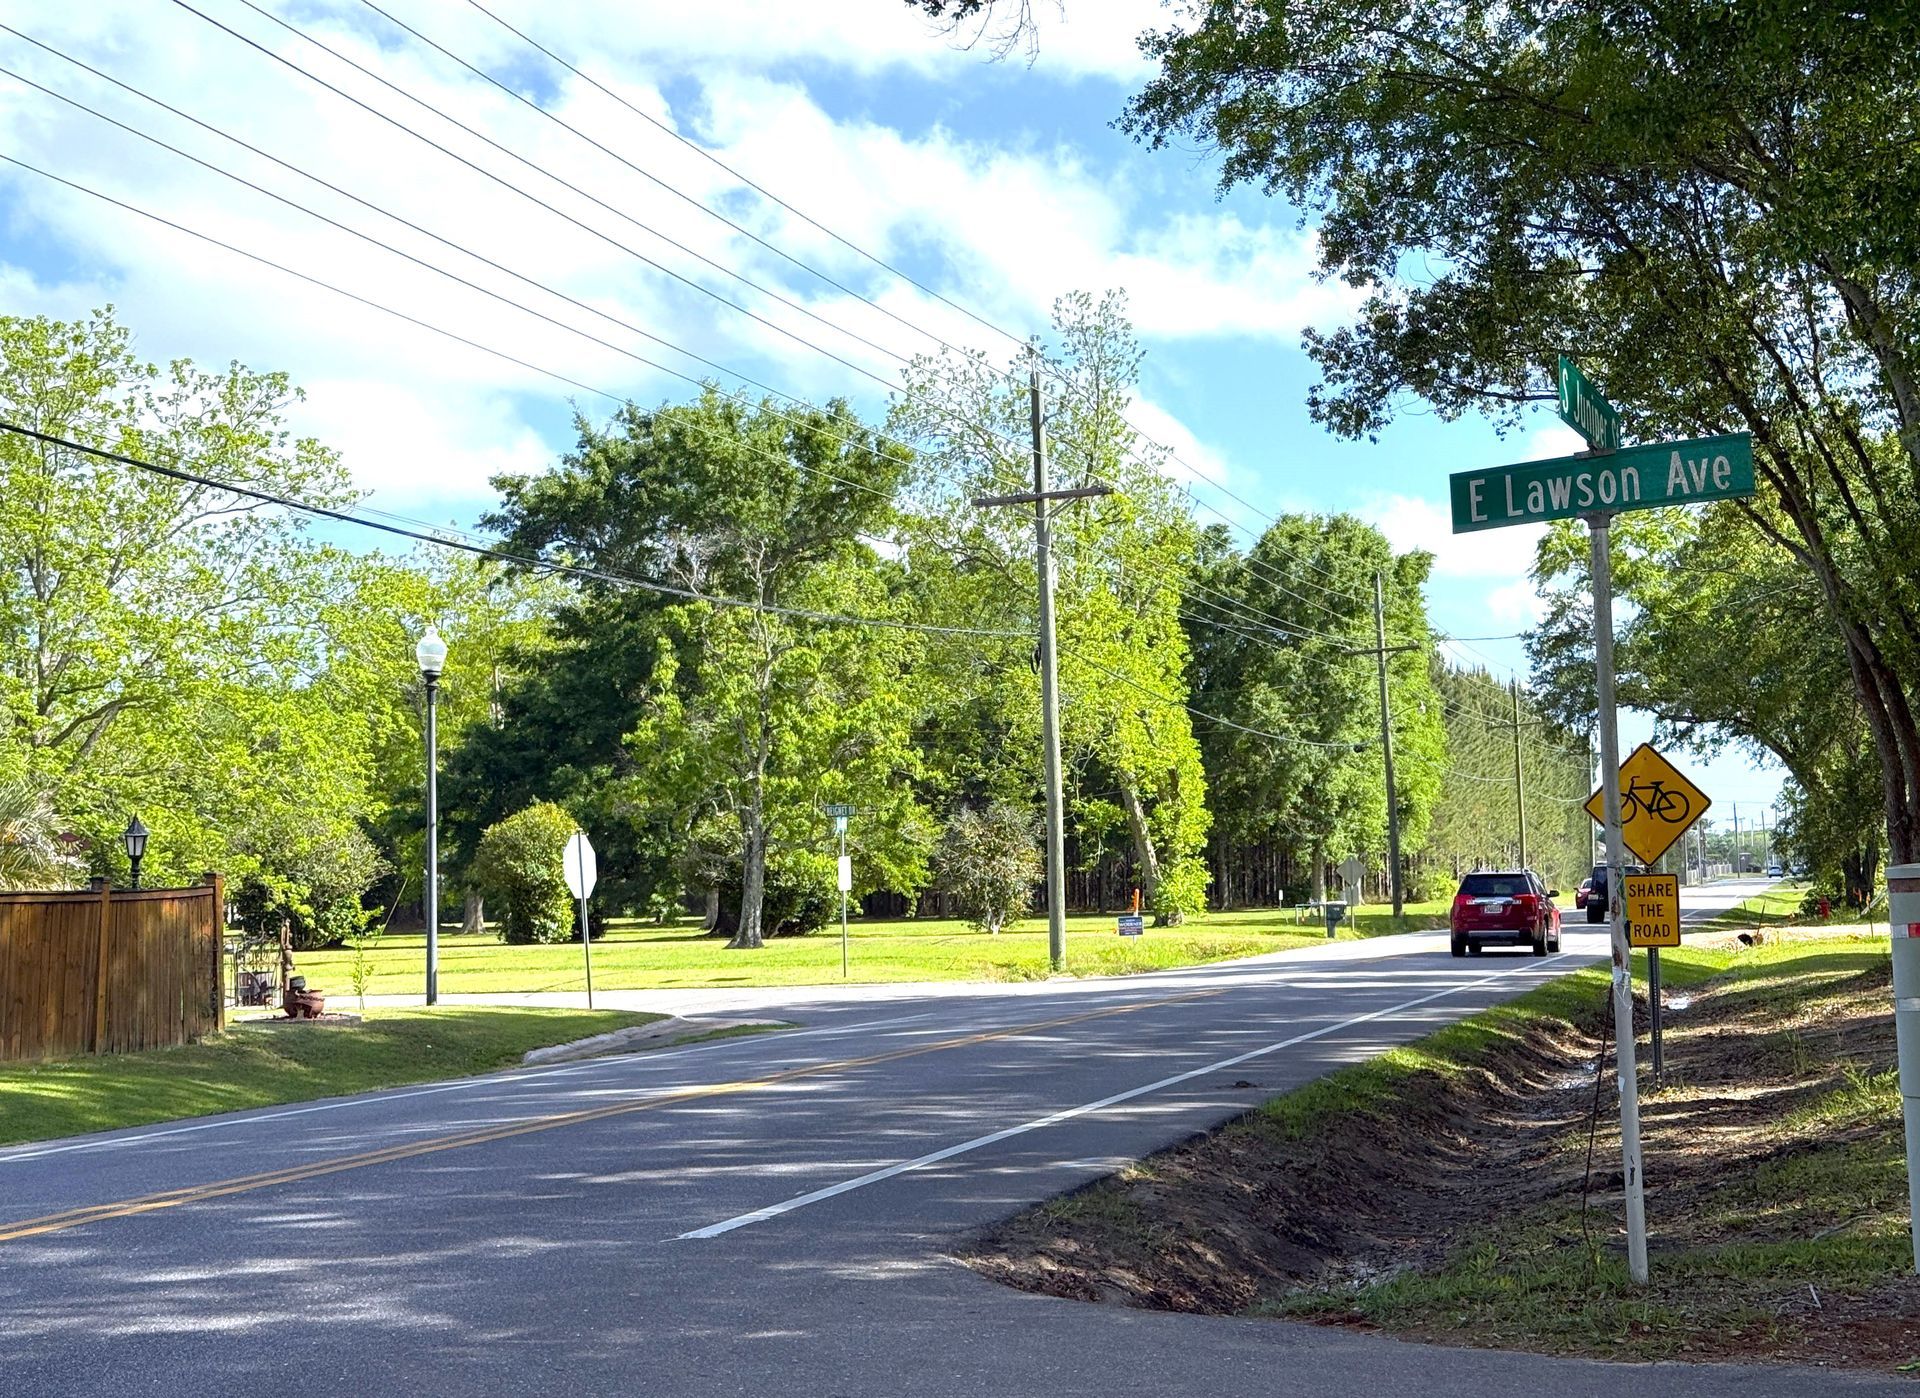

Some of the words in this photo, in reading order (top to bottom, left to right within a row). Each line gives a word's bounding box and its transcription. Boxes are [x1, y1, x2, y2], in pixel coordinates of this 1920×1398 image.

[1562, 367, 1569, 414] S
[1573, 379, 1608, 448] Juniper
[1469, 478, 1488, 523] E
[1505, 466, 1641, 517] Lawson
[1665, 450, 1732, 497] Ave
[1629, 884, 1673, 897] SHARE
[1638, 904, 1664, 917] THE
[1634, 924, 1670, 937] ROAD
